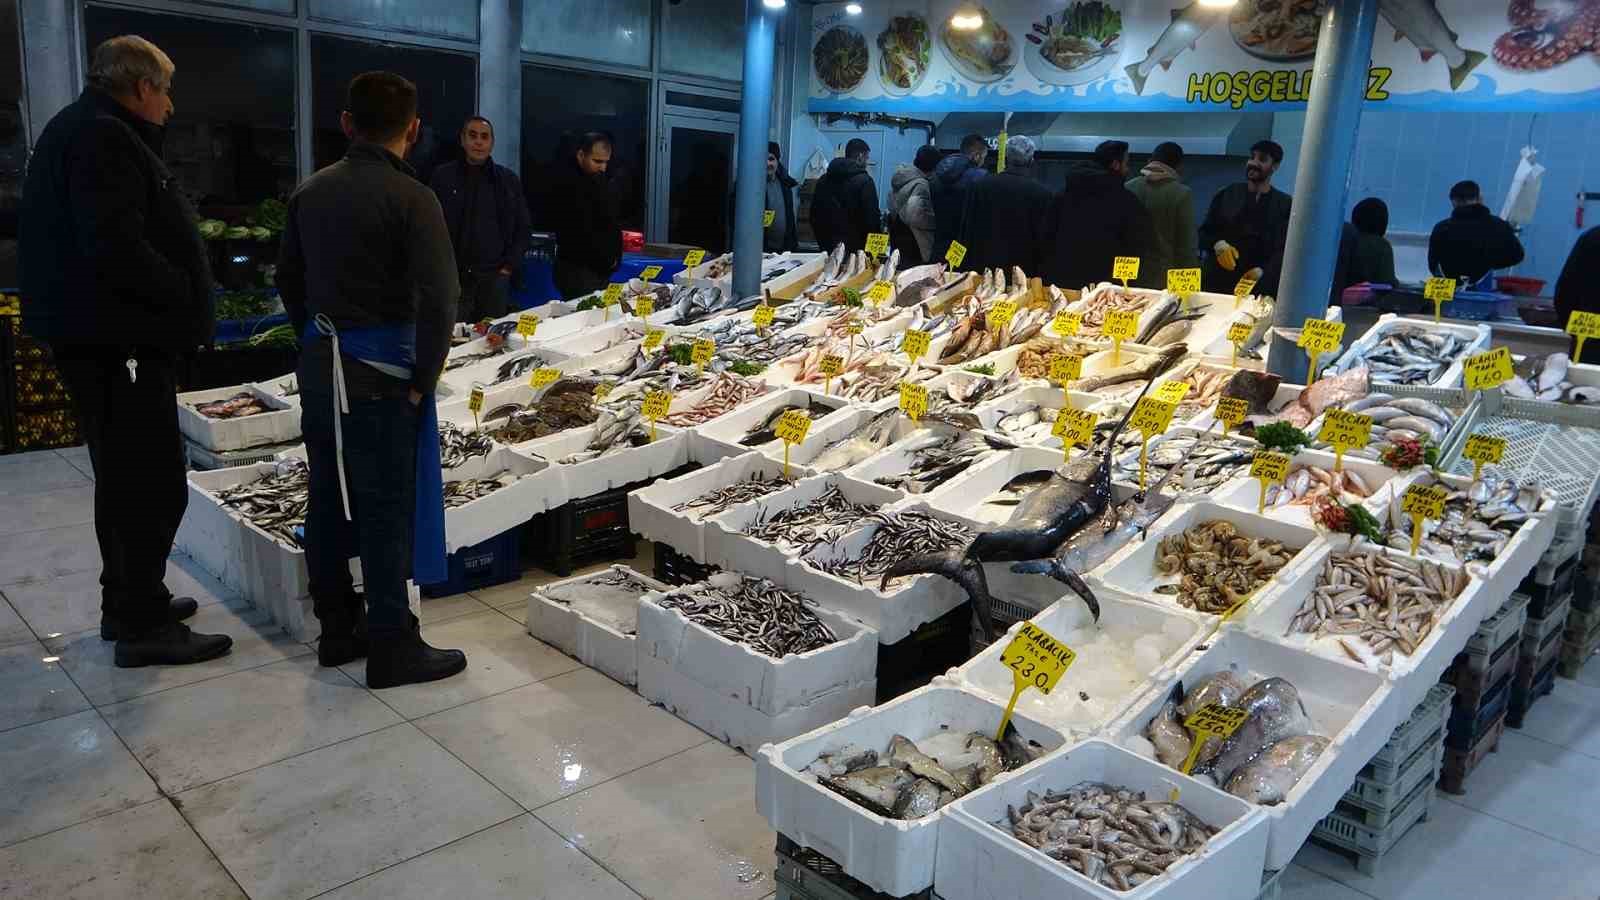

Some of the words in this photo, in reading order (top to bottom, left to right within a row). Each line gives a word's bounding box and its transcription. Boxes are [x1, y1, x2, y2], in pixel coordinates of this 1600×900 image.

[1109, 327, 1127, 335] 300
[1058, 425, 1081, 441] 200
[1135, 418, 1160, 432] 500
[1326, 431, 1359, 447] 200
[1253, 467, 1279, 481] 500
[1404, 502, 1435, 518] 150
[1010, 655, 1049, 688] 230
[1191, 718, 1223, 734] 150
